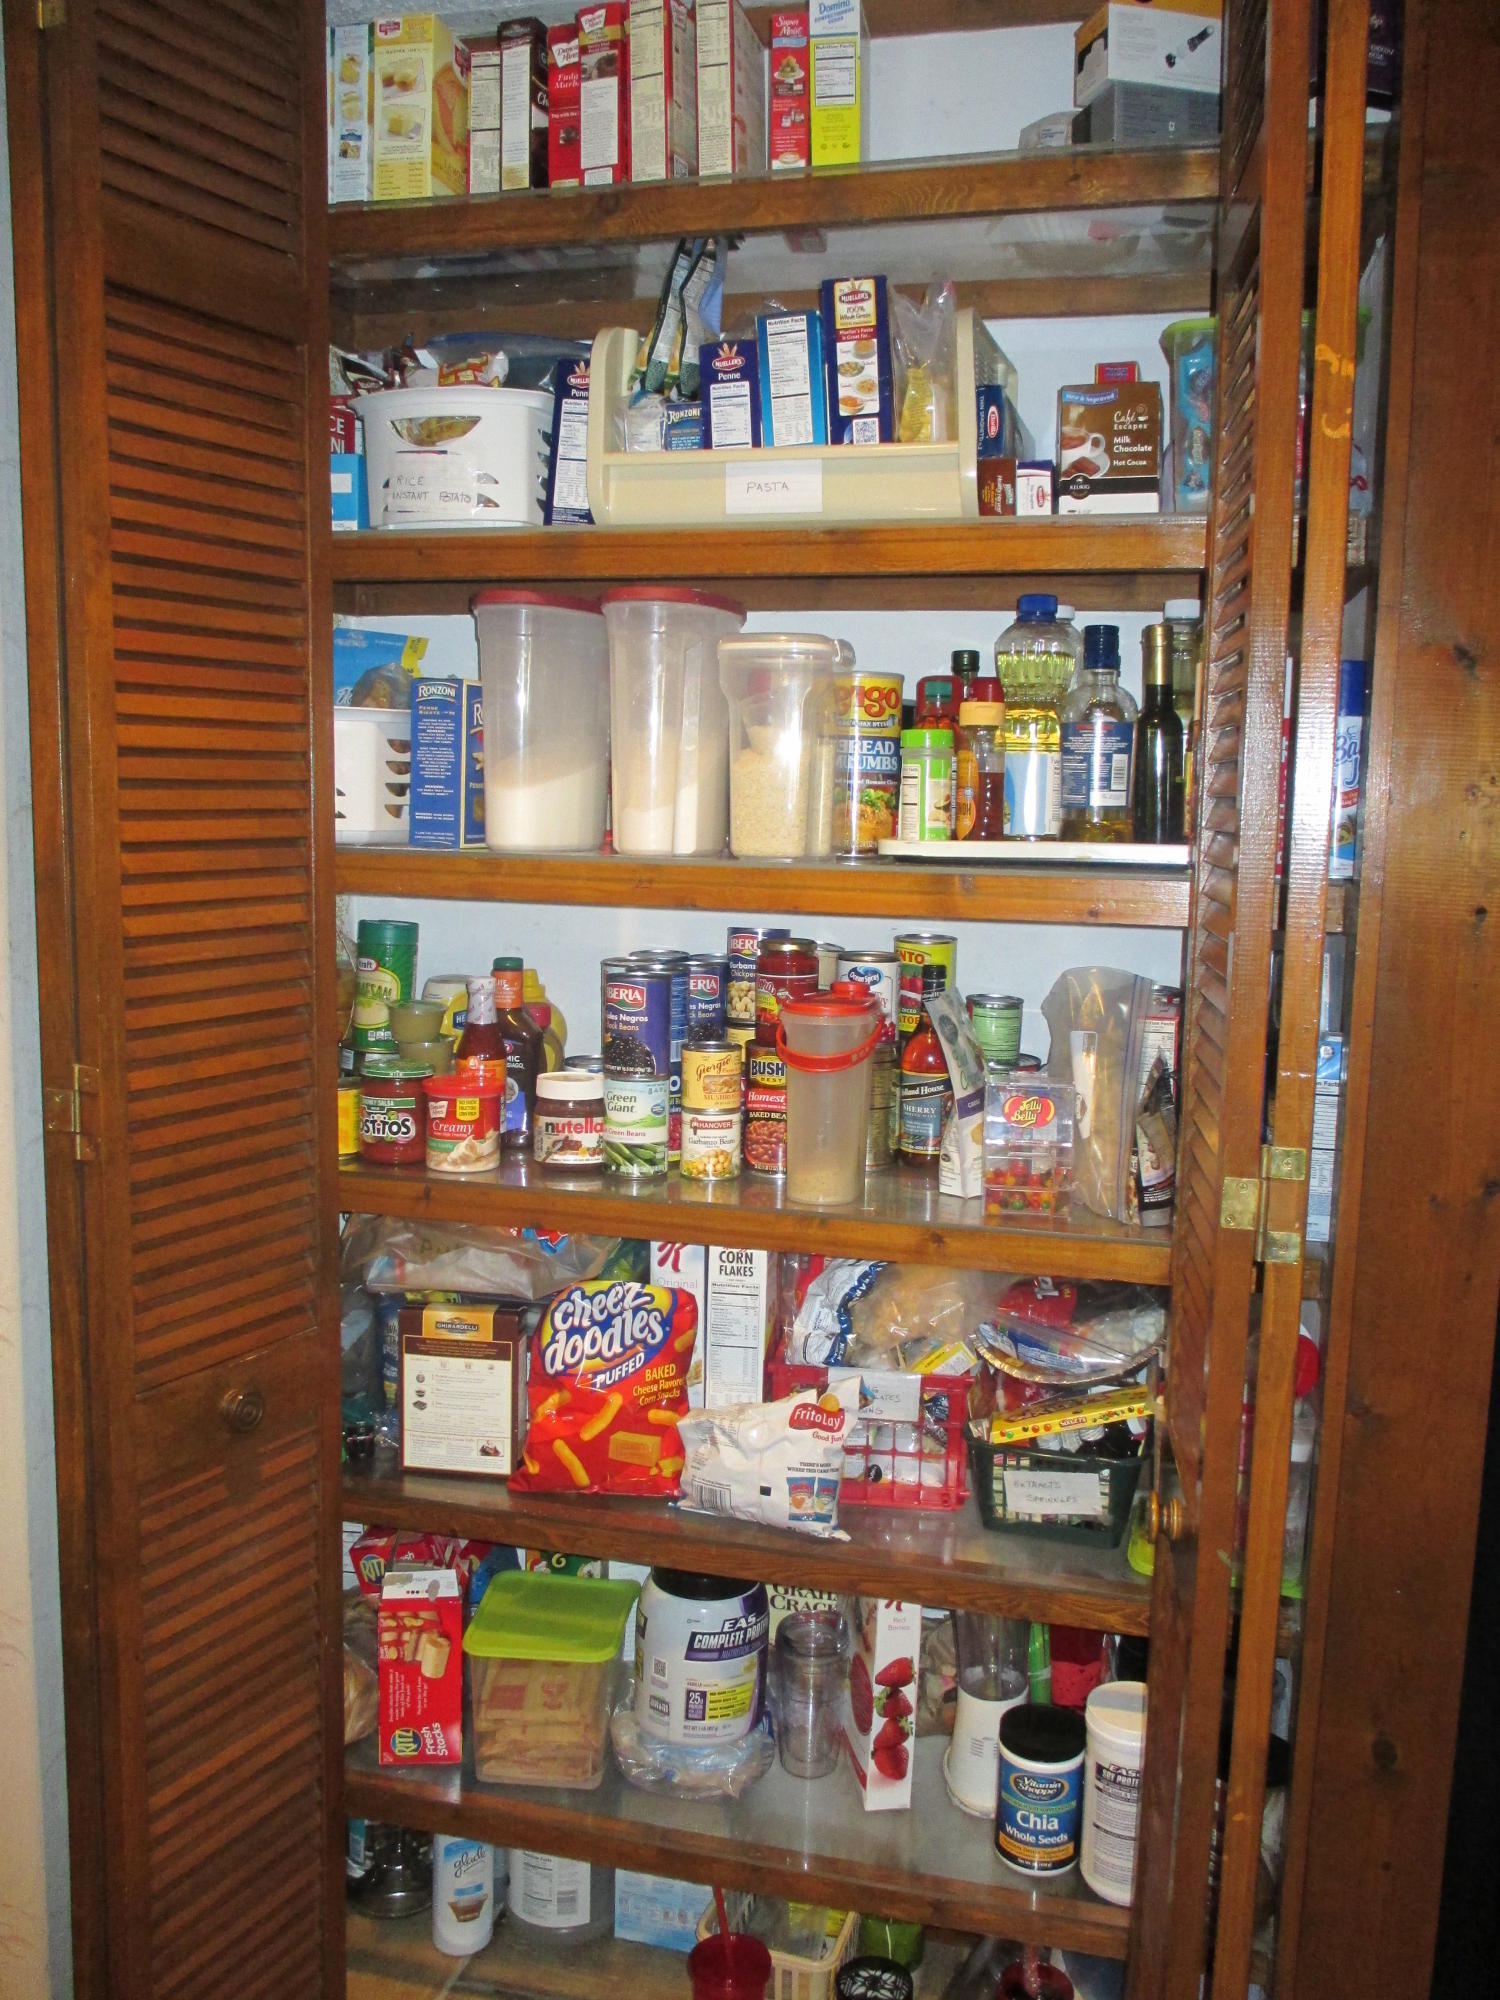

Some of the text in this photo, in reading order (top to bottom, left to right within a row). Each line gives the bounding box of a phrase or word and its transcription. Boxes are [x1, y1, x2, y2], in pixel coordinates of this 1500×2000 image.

[776, 16, 800, 27] Super
[718, 372, 741, 381] Penne
[571, 388, 589, 398] Penn
[668, 407, 700, 425] RONZONI
[1113, 435, 1131, 445] Milk
[1113, 444, 1153, 454] Chocolate
[746, 481, 790, 495] PASTA
[418, 685, 456, 698] RONZONI
[730, 938, 758, 953] IBERI
[360, 961, 373, 969] raft
[849, 972, 880, 984] Ocean Spray
[690, 978, 718, 992] ERIA
[698, 1003, 721, 1011] Negros
[619, 1013, 649, 1023] Negros
[619, 1023, 640, 1032] Beans
[696, 1054, 732, 1081] Giorgio
[751, 1059, 785, 1076] BUSH
[748, 1091, 786, 1103] Homest
[921, 1085, 944, 1096] House
[606, 1091, 637, 1104] Green
[606, 1102, 635, 1113] Giant
[903, 1103, 937, 1114] SHERRY
[1020, 1100, 1042, 1113] Jelly
[771, 1111, 787, 1120] BEA
[1010, 1109, 1037, 1121] Belly
[432, 1119, 474, 1137] Creamy
[544, 1112, 604, 1135] nutella
[698, 1121, 732, 1130] HANOVER
[608, 1128, 625, 1136] Green
[688, 1138, 718, 1146] Garbanzo
[718, 1250, 754, 1265] CORN
[719, 1264, 755, 1277] FLAKES
[656, 1277, 698, 1289] Original
[553, 1281, 652, 1332] cheez
[436, 1322, 478, 1331] GHIRARDELLI
[544, 1308, 664, 1375] doodles
[596, 1351, 645, 1389] PUFFED
[645, 1363, 676, 1382] BAKED
[632, 1376, 684, 1396] Cheese Flavore
[639, 1388, 681, 1406] Corn Snacks
[812, 1430, 844, 1445] Good fun!
[360, 1558, 385, 1583] RITZ
[693, 1629, 745, 1649] COMPLETE
[395, 1729, 419, 1756] RITZ
[420, 1726, 437, 1755] Fresh
[430, 1721, 449, 1756] Stacks
[1023, 1776, 1062, 1788] Vitamin
[1116, 1773, 1140, 1788] PROTE
[1018, 1783, 1057, 1796] Shoppe
[1016, 1810, 1060, 1831] Chia
[1005, 1822, 1069, 1844] Whole Seeds
